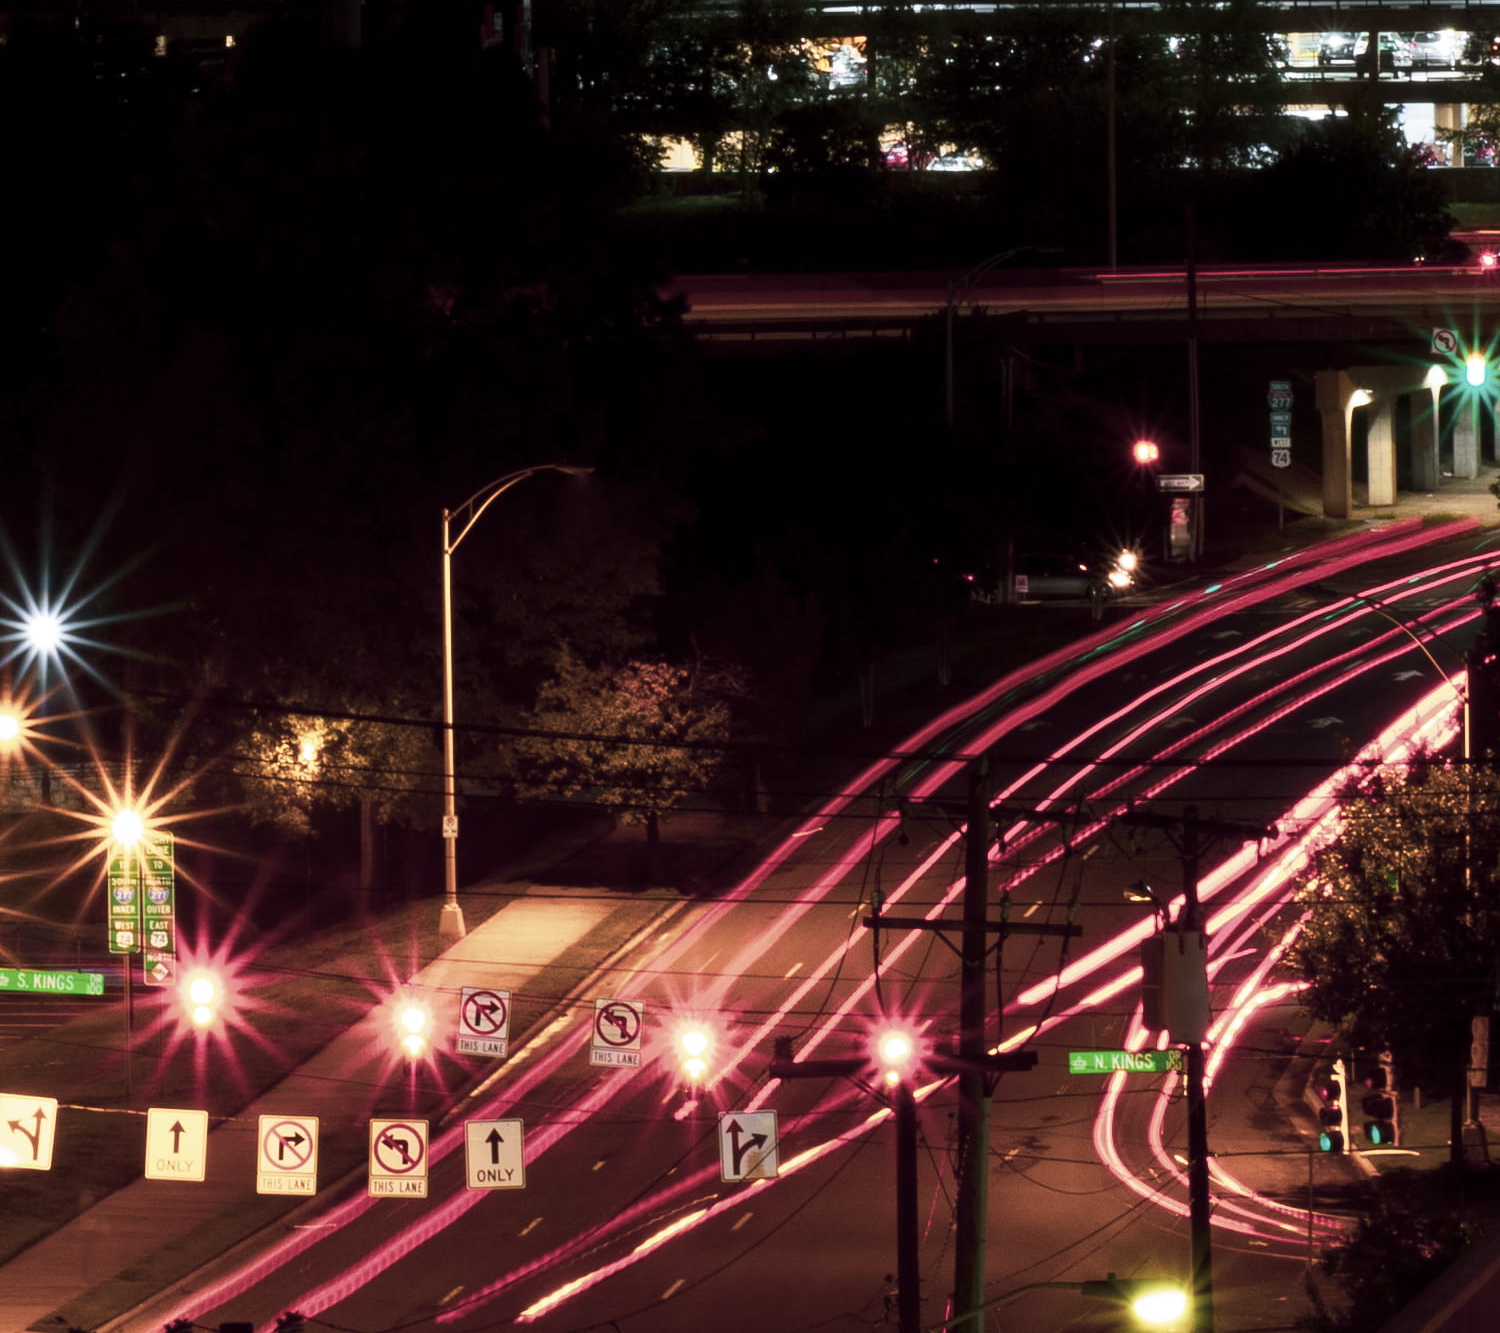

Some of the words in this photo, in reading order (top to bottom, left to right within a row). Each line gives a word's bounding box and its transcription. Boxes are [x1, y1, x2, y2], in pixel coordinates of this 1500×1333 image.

[1272, 398, 1291, 408] 277
[1275, 452, 1287, 464] 74
[153, 860, 164, 870] TO
[146, 905, 171, 914] OUTER
[149, 919, 169, 930] EAST
[154, 933, 166, 944] 74
[17, 972, 29, 988] S.
[33, 973, 75, 990] KINGS
[89, 974, 103, 983] DR
[460, 1039, 479, 1052] THIS
[482, 1042, 504, 1054] LANE
[594, 1051, 613, 1063] THIS
[616, 1053, 638, 1065] LANE
[1095, 1055, 1107, 1069] N.
[1111, 1053, 1153, 1070] KINGS
[156, 1159, 195, 1173] ONLY
[476, 1169, 514, 1183] ONLY
[262, 1177, 283, 1190] THIS
[288, 1179, 312, 1191] LANE
[374, 1180, 395, 1192] THIS
[399, 1181, 423, 1193] LANE
